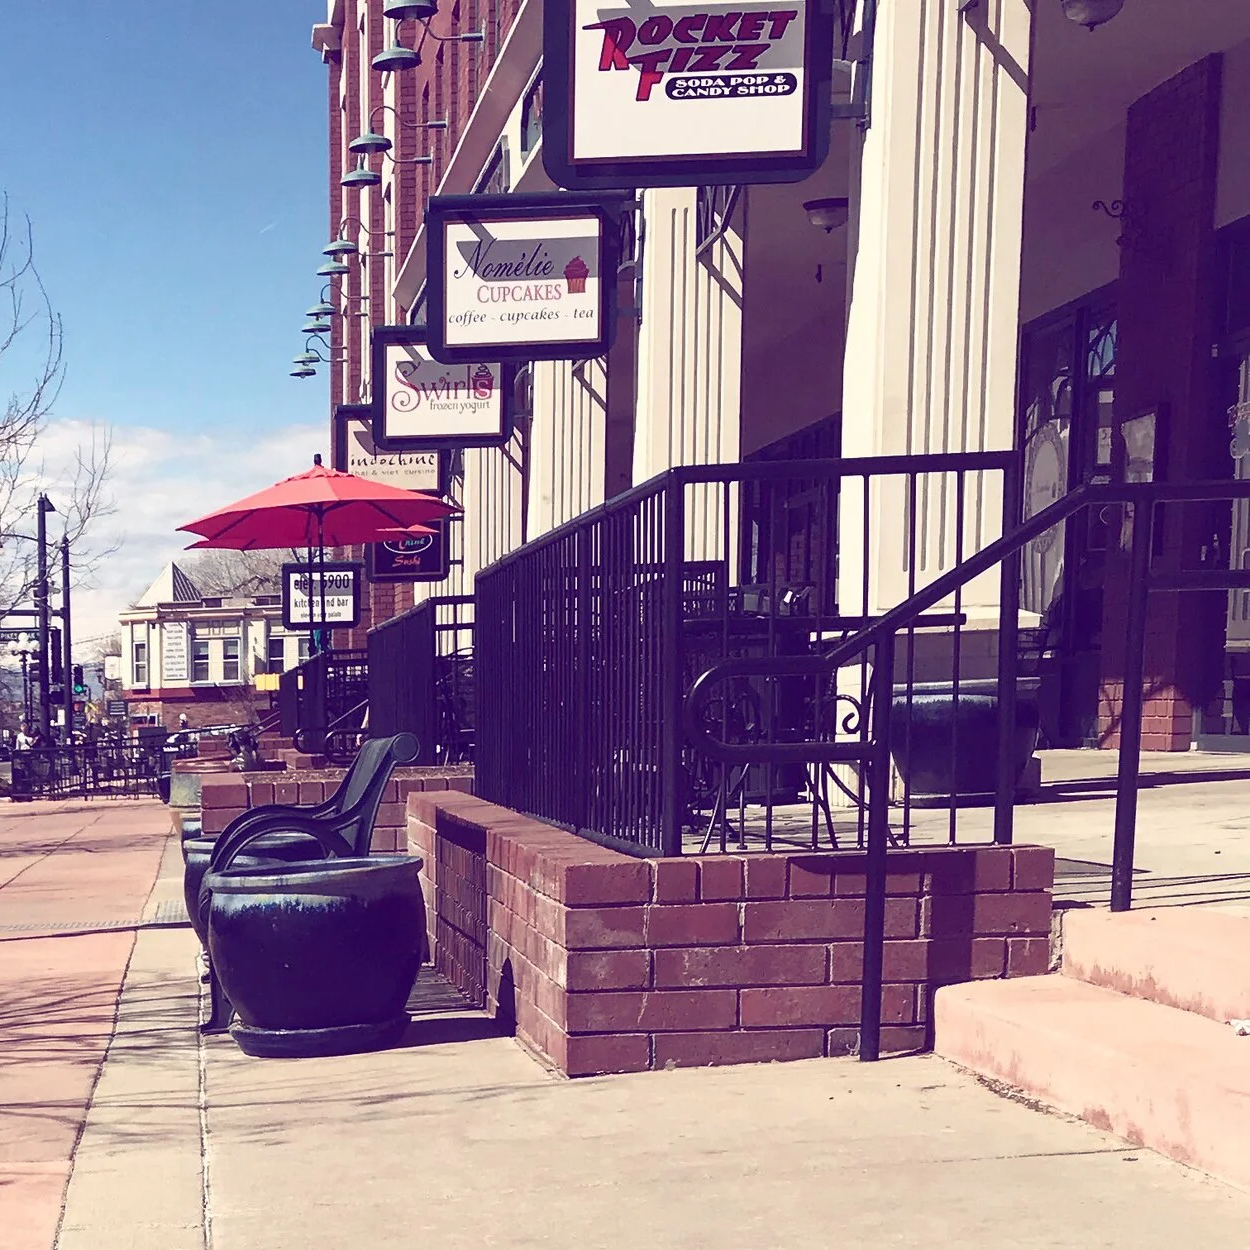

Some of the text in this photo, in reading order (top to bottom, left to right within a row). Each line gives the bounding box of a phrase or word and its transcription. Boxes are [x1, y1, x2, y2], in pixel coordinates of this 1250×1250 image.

[582, 10, 798, 71] ROCKET
[628, 43, 771, 101] FIZZ
[675, 75, 787, 88] SODA POP &
[671, 85, 791, 98] CANDY SHOP
[453, 237, 554, 279] Nomélie
[477, 284, 562, 303] CUPCAKES
[448, 310, 487, 327] coffee
[499, 307, 560, 325] cupcakes
[573, 308, 594, 319] tea
[391, 361, 494, 412] Swirls
[430, 399, 491, 414] frozen yogurt
[351, 447, 435, 466] indochine
[293, 574, 317, 590] ele.
[294, 598, 320, 608] kitcen
[337, 597, 348, 606] bar
